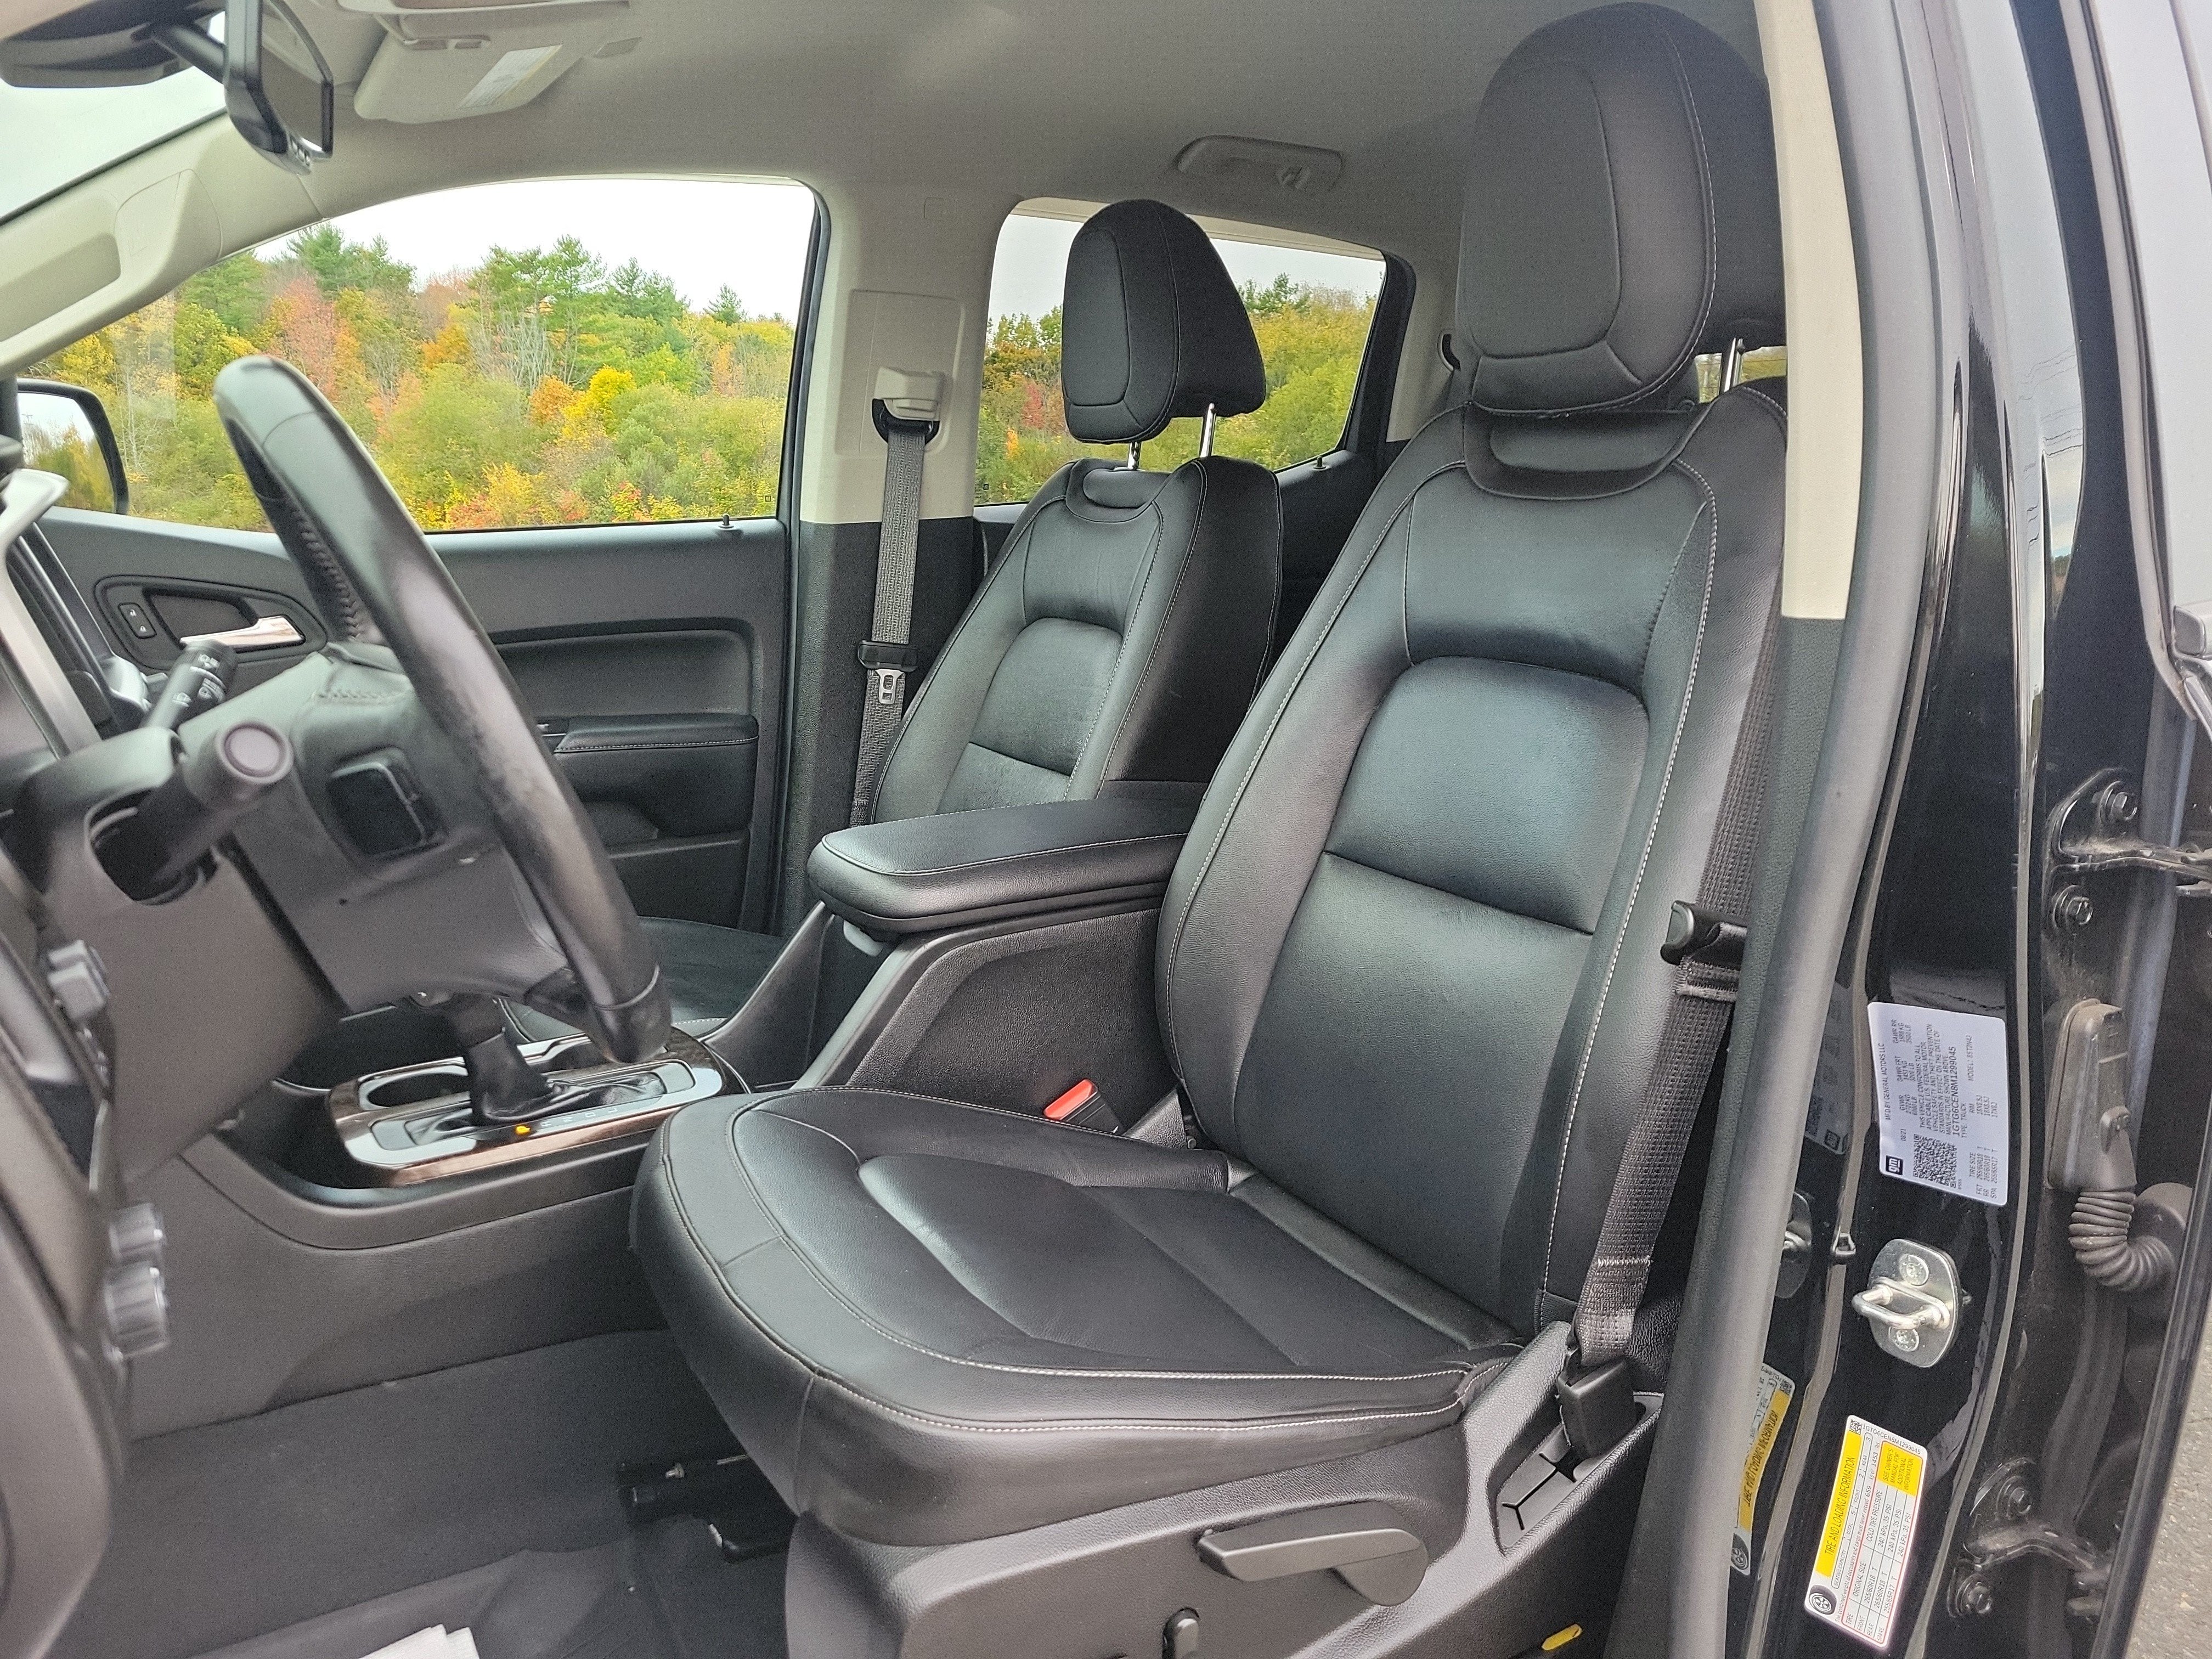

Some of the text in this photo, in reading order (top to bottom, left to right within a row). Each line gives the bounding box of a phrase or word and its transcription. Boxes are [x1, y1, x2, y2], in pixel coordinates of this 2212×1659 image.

[1891, 1019, 1897, 1027] RR
[1879, 1054, 1887, 1075] MOTORS
[1949, 1047, 1960, 1136] 1GTG6CEN8M1299045
[1863, 1424, 1921, 1454] 1GTG6CEN8M1299045
[1890, 1464, 1898, 1483] MANUAL
[1897, 1458, 1907, 1485] ADDITIONAL
[1904, 1459, 1914, 1490] INFORMATION
[1825, 1455, 1855, 1556] TIRE AND LOADING INFORMATION
[1853, 1574, 1864, 1596] ORIGINAL
[1872, 1490, 1882, 1516] PRESSURE
[1848, 1555, 1856, 1576] occupants
[1864, 1575, 1875, 1603] 265/60R18
[1874, 1580, 1886, 1608] 265/60R18
[1884, 1584, 1894, 1613] 255/65R17
